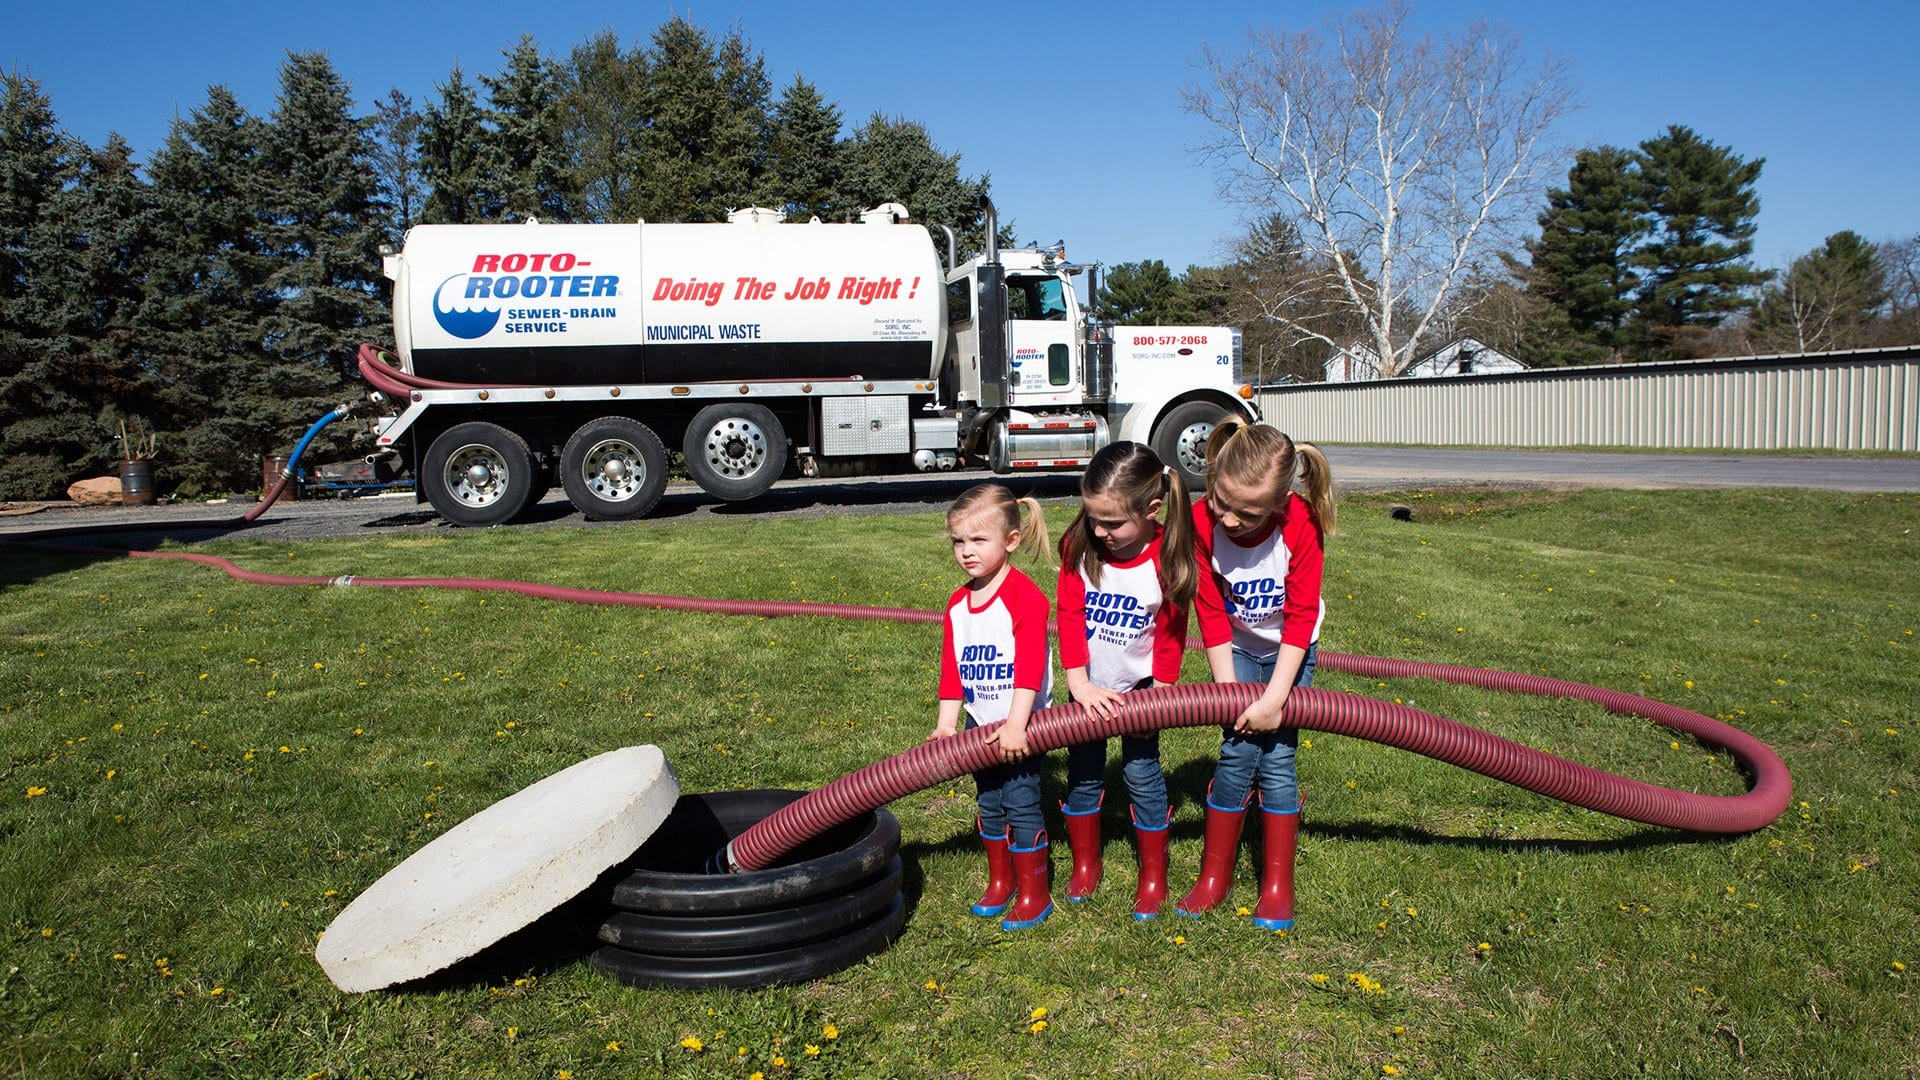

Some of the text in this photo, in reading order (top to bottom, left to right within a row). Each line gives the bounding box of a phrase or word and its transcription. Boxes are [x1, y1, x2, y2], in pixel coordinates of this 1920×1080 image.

[472, 253, 592, 273] ROTO-
[464, 275, 620, 299] ROOTER
[652, 277, 725, 307] Doing
[733, 277, 776, 300] The
[784, 277, 831, 300] Job
[837, 276, 902, 305] Right
[508, 307, 616, 320] SEWER-DRAIN
[505, 322, 567, 333] SERVICE
[647, 323, 761, 341] MUNICIPAL WASTE
[1216, 355, 1229, 365] 20
[1232, 578, 1284, 596] OTO-
[1085, 591, 1145, 611] ROTO-
[1098, 634, 1128, 647] SERVICE
[961, 644, 1003, 662] ROTO-
